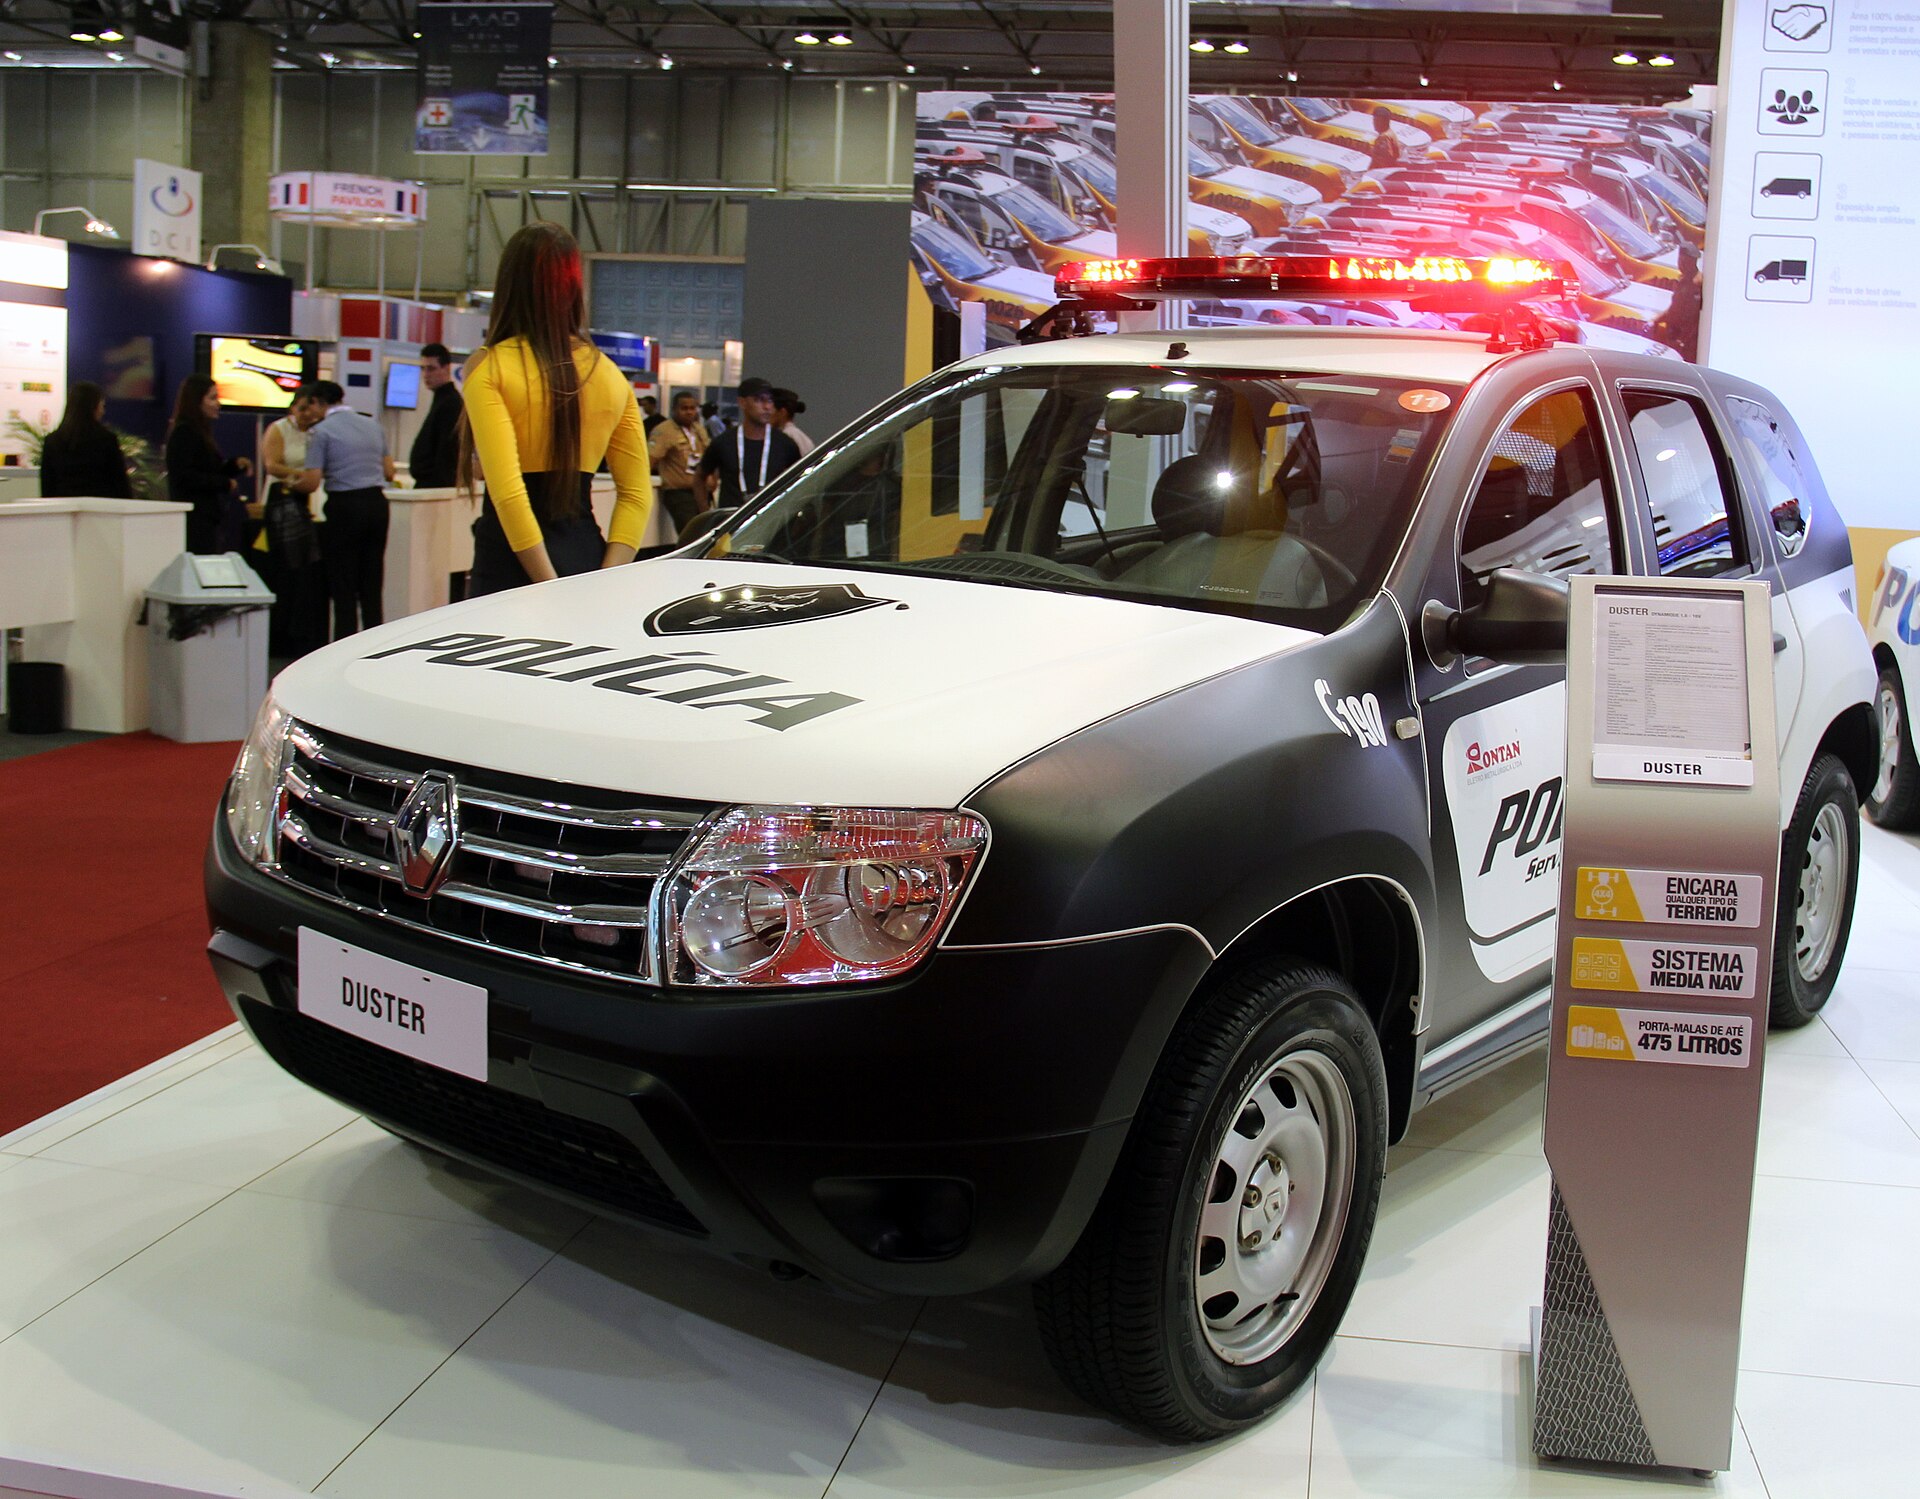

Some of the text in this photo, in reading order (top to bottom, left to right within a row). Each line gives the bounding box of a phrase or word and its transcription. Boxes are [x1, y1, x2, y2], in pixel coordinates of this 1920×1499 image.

[451, 11, 520, 26] LAAD
[333, 182, 384, 195] FRENCH
[331, 195, 385, 208] PAVILION
[1409, 394, 1440, 408] 11
[1608, 606, 1649, 616] DUSTER
[358, 633, 866, 733] POLÍCIA
[1335, 693, 1388, 749] 190
[1643, 761, 1703, 776] DUSTER
[1524, 853, 1560, 883] Serv
[1666, 877, 1738, 897] ENCARA
[1666, 896, 1738, 906] QUALQUER TIPO DE
[1666, 904, 1737, 922] TERRENO
[1651, 949, 1744, 973] SISTEMA
[1650, 971, 1743, 991] MEDIA NAV
[342, 976, 426, 1035] DUSTER
[1638, 1021, 1744, 1037] PORTA-MALAS DE ATÉ
[1638, 1033, 1743, 1055] 475 LITROS
